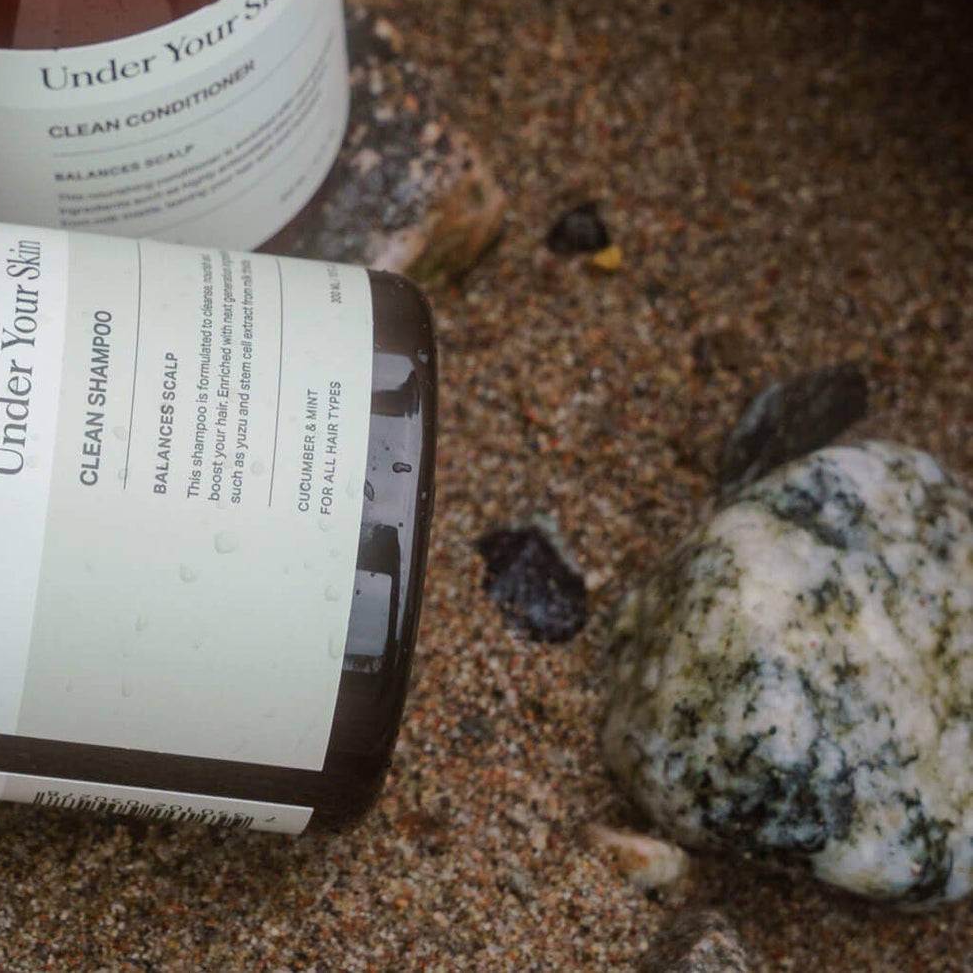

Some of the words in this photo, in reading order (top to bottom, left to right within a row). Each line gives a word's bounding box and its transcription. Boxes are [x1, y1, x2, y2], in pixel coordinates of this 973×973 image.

[39, 55, 157, 91] Under
[164, 15, 239, 62] Your
[48, 118, 120, 139] CLEAN
[126, 60, 255, 128] CONDITIONER
[54, 162, 141, 182] BALANCES
[144, 143, 194, 168] SCALP
[6, 239, 41, 281] Skin
[1, 284, 39, 350] Your
[201, 318, 213, 329] to
[223, 304, 233, 324] next
[243, 307, 254, 339] extract
[220, 324, 233, 346] with
[240, 340, 253, 360] cell
[88, 310, 113, 407] SHAMPOO
[197, 330, 213, 391] formulated
[217, 347, 232, 398] Enriched
[162, 352, 178, 401] SCALP
[239, 361, 252, 391] stem
[195, 393, 208, 404] is
[215, 400, 229, 427] hair.
[238, 392, 250, 416] and
[305, 388, 318, 420] MINT
[328, 380, 342, 420] TYPES
[191, 405, 208, 467] shampoo
[214, 428, 227, 459] your
[236, 418, 249, 450] yuzu
[305, 423, 317, 432] &
[326, 423, 339, 454] HAIR
[80, 411, 105, 486] CLEAN
[153, 404, 175, 495] BALANCES
[234, 451, 245, 468] as
[187, 469, 202, 499] This
[207, 460, 223, 501] boost
[297, 435, 316, 512] CUCUMBER
[323, 457, 336, 483] ALL
[230, 470, 243, 504] such
[320, 486, 334, 515] FOR
